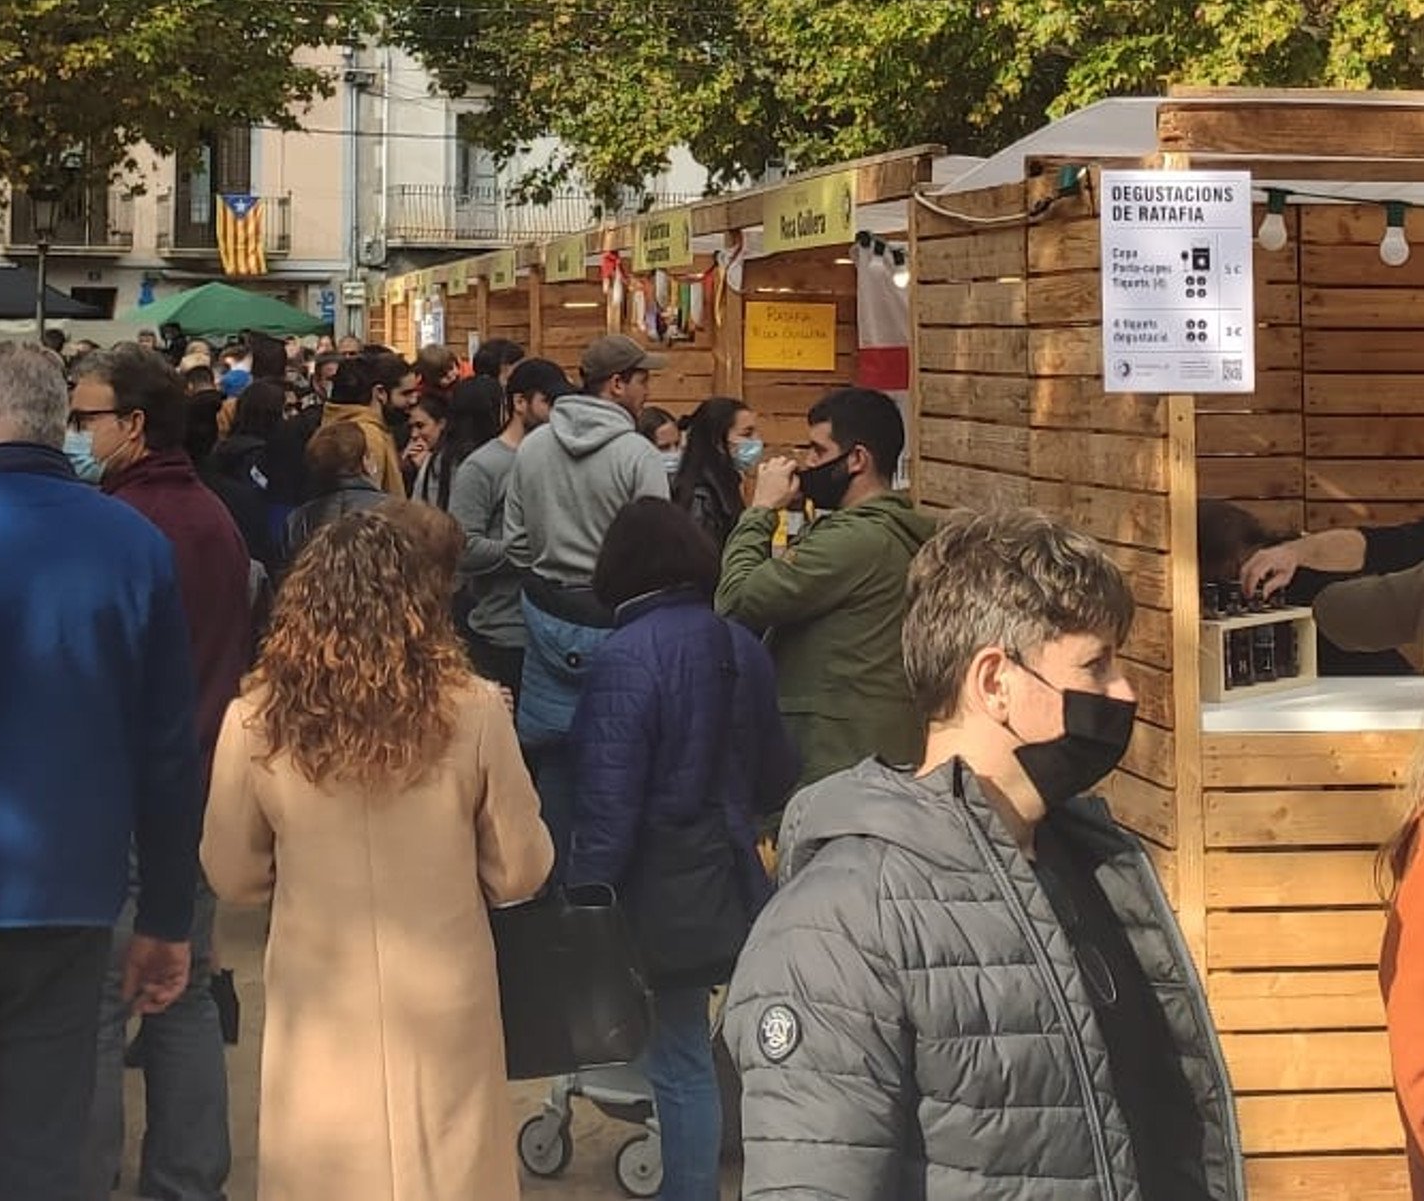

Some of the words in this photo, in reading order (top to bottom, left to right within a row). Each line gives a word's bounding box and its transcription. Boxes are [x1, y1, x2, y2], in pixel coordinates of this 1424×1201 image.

[1112, 186, 1234, 202] DEGUSTACIONS
[1112, 206, 1133, 221] DE
[1138, 206, 1204, 222] RATAFIA
